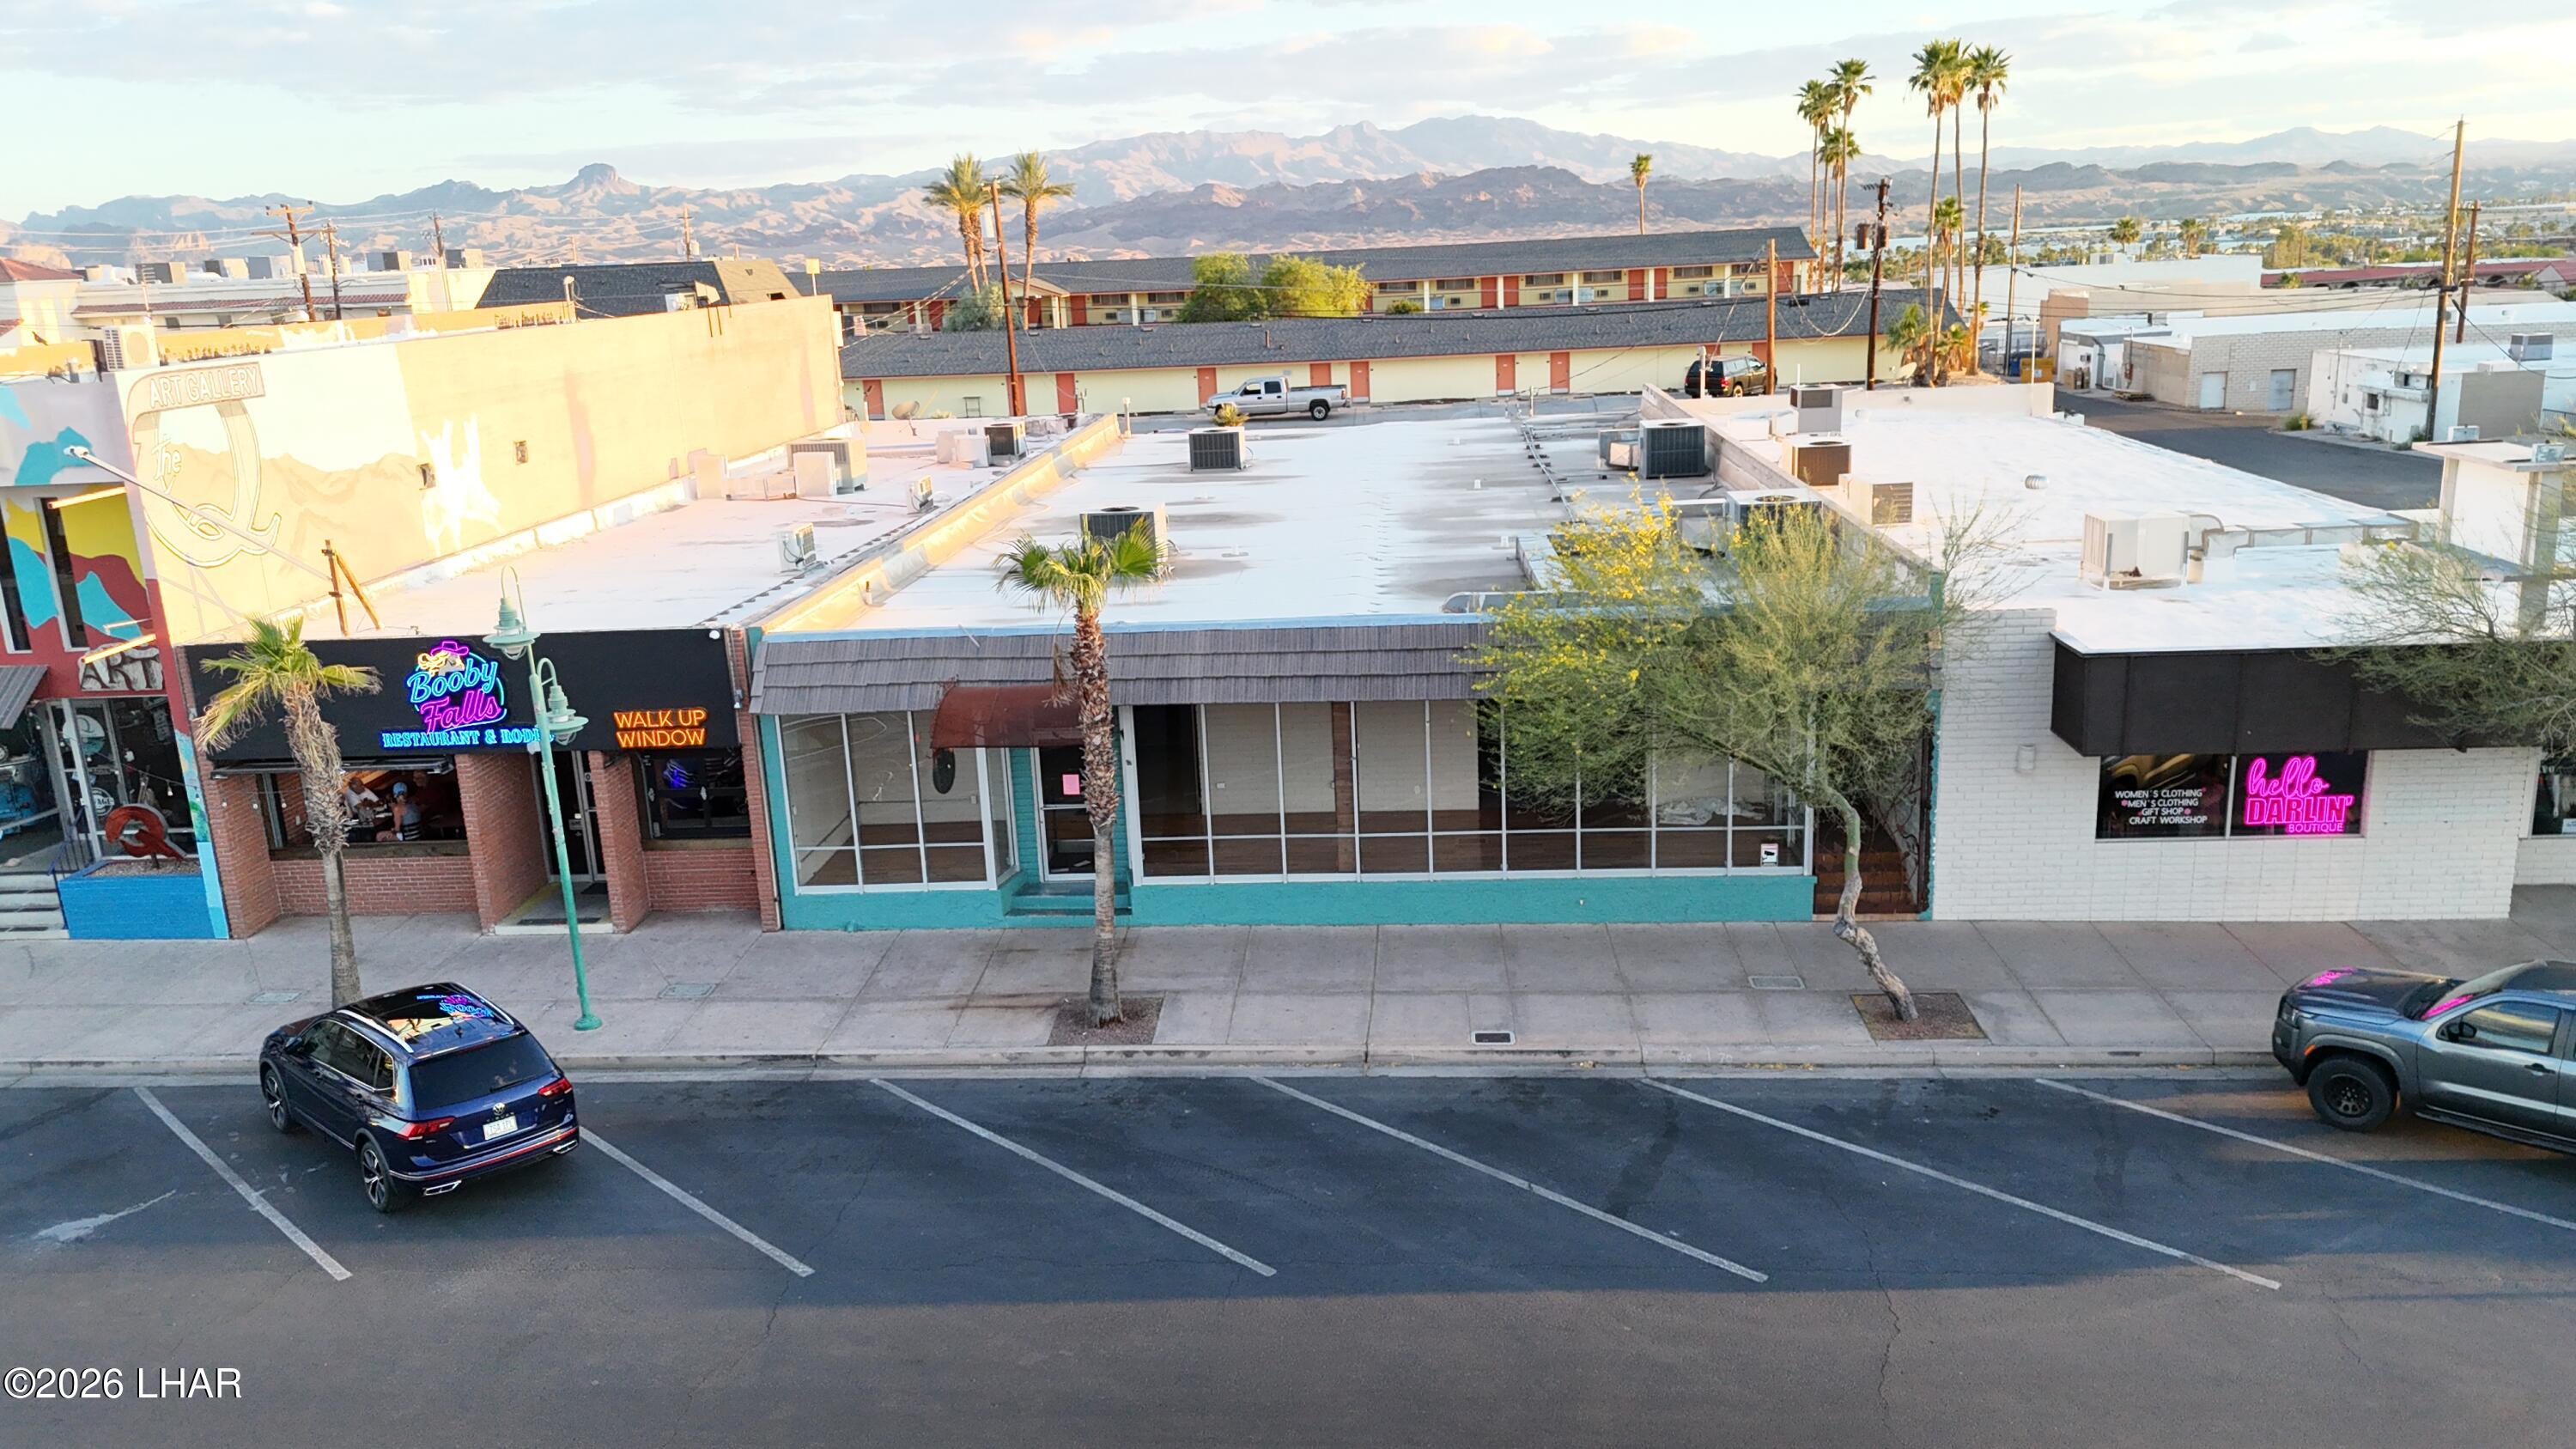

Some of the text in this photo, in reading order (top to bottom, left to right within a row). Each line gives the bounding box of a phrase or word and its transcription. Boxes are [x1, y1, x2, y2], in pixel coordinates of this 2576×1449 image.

[150, 366, 258, 408] ART GALLERY
[80, 644, 161, 691] ART
[406, 658, 498, 703] Booby
[420, 688, 501, 734] Falls
[614, 709, 706, 728] WALK UP
[382, 728, 554, 747] RESTAURANT & RODE
[617, 728, 705, 747] WINDOW
[2248, 757, 2330, 798] hello
[2115, 788, 2203, 799] WOMEN'S CLOTHING
[2127, 798, 2199, 808] MEN'S CLOTHING
[2142, 807, 2184, 816] GIFT SHOP
[2245, 795, 2354, 825] DARLIN'
[2160, 815, 2208, 825] WORKSHOP
[2288, 823, 2344, 833] BOUTIQUE
